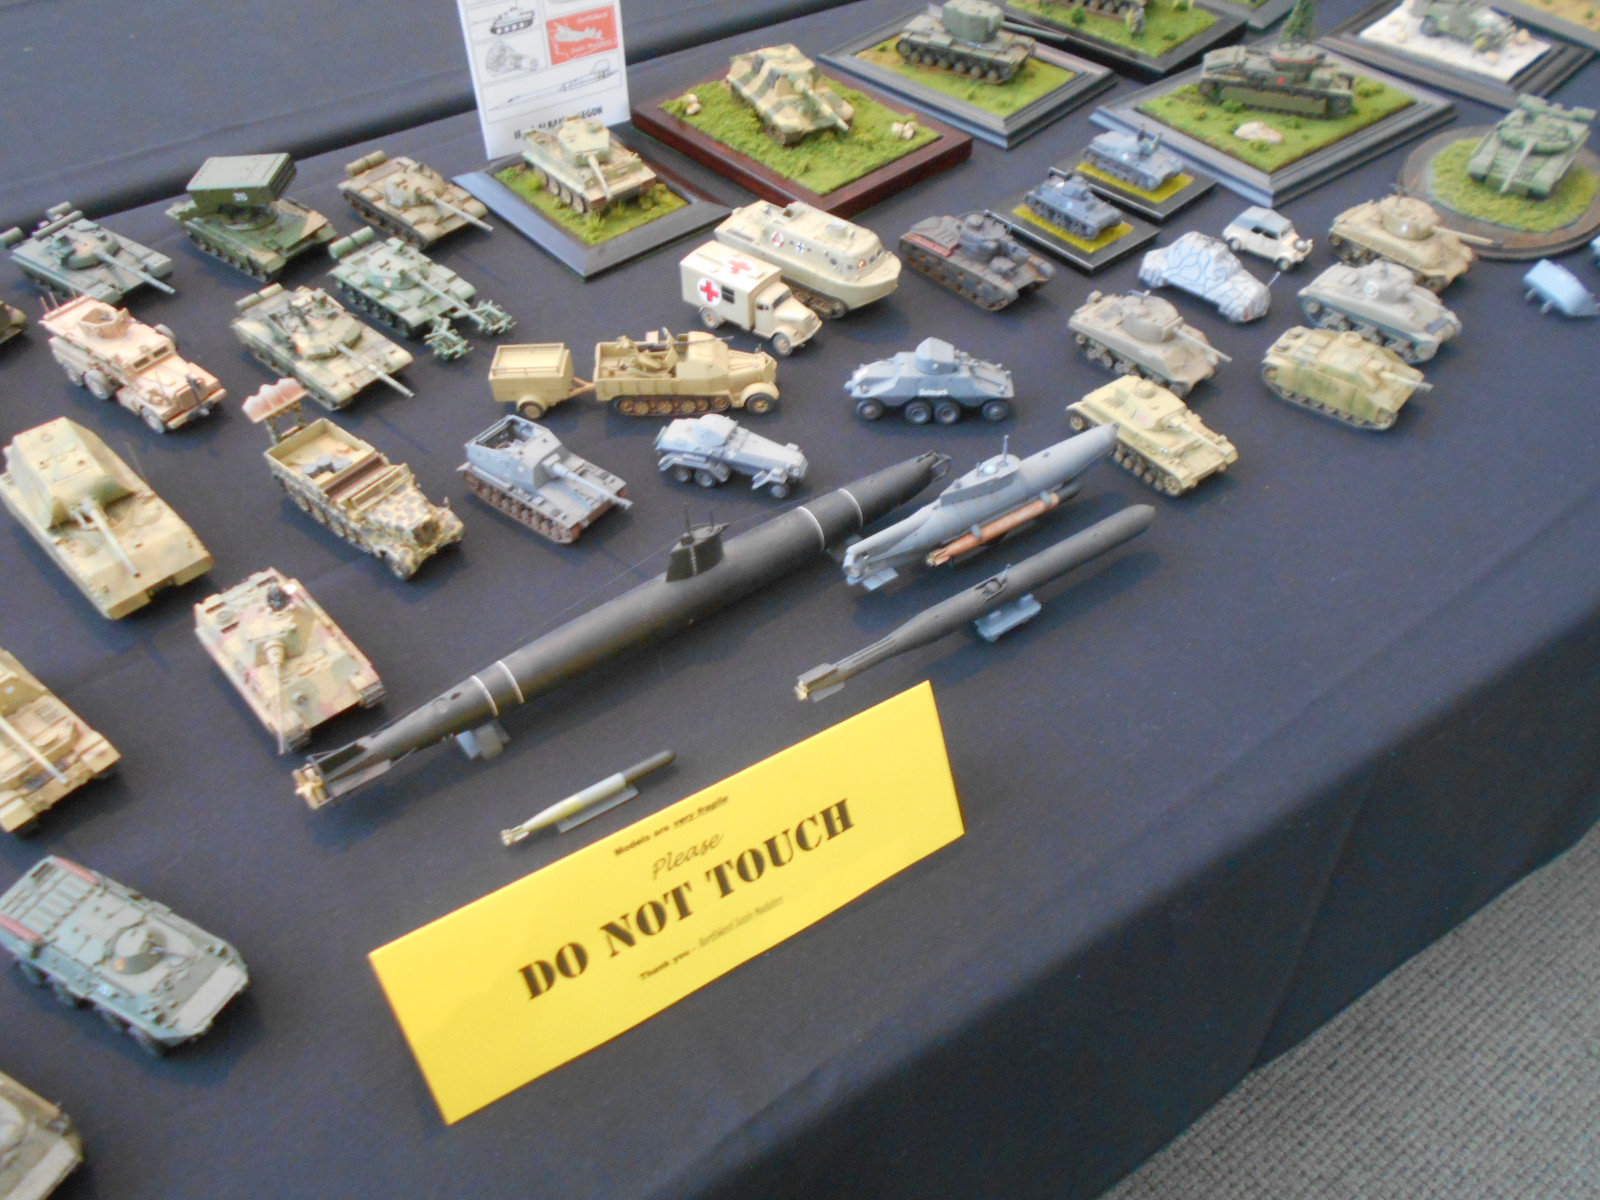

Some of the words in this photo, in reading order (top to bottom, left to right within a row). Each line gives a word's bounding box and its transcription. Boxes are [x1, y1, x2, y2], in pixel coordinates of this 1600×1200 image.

[613, 834, 652, 858] Models
[653, 824, 671, 839] are
[672, 812, 696, 831] very
[696, 795, 730, 819] fragile
[652, 832, 724, 881] Please
[517, 940, 589, 1000] DO
[599, 880, 694, 958] NOT
[704, 797, 856, 900] TOUCH
[638, 960, 672, 981] Thank
[672, 949, 691, 966] you
